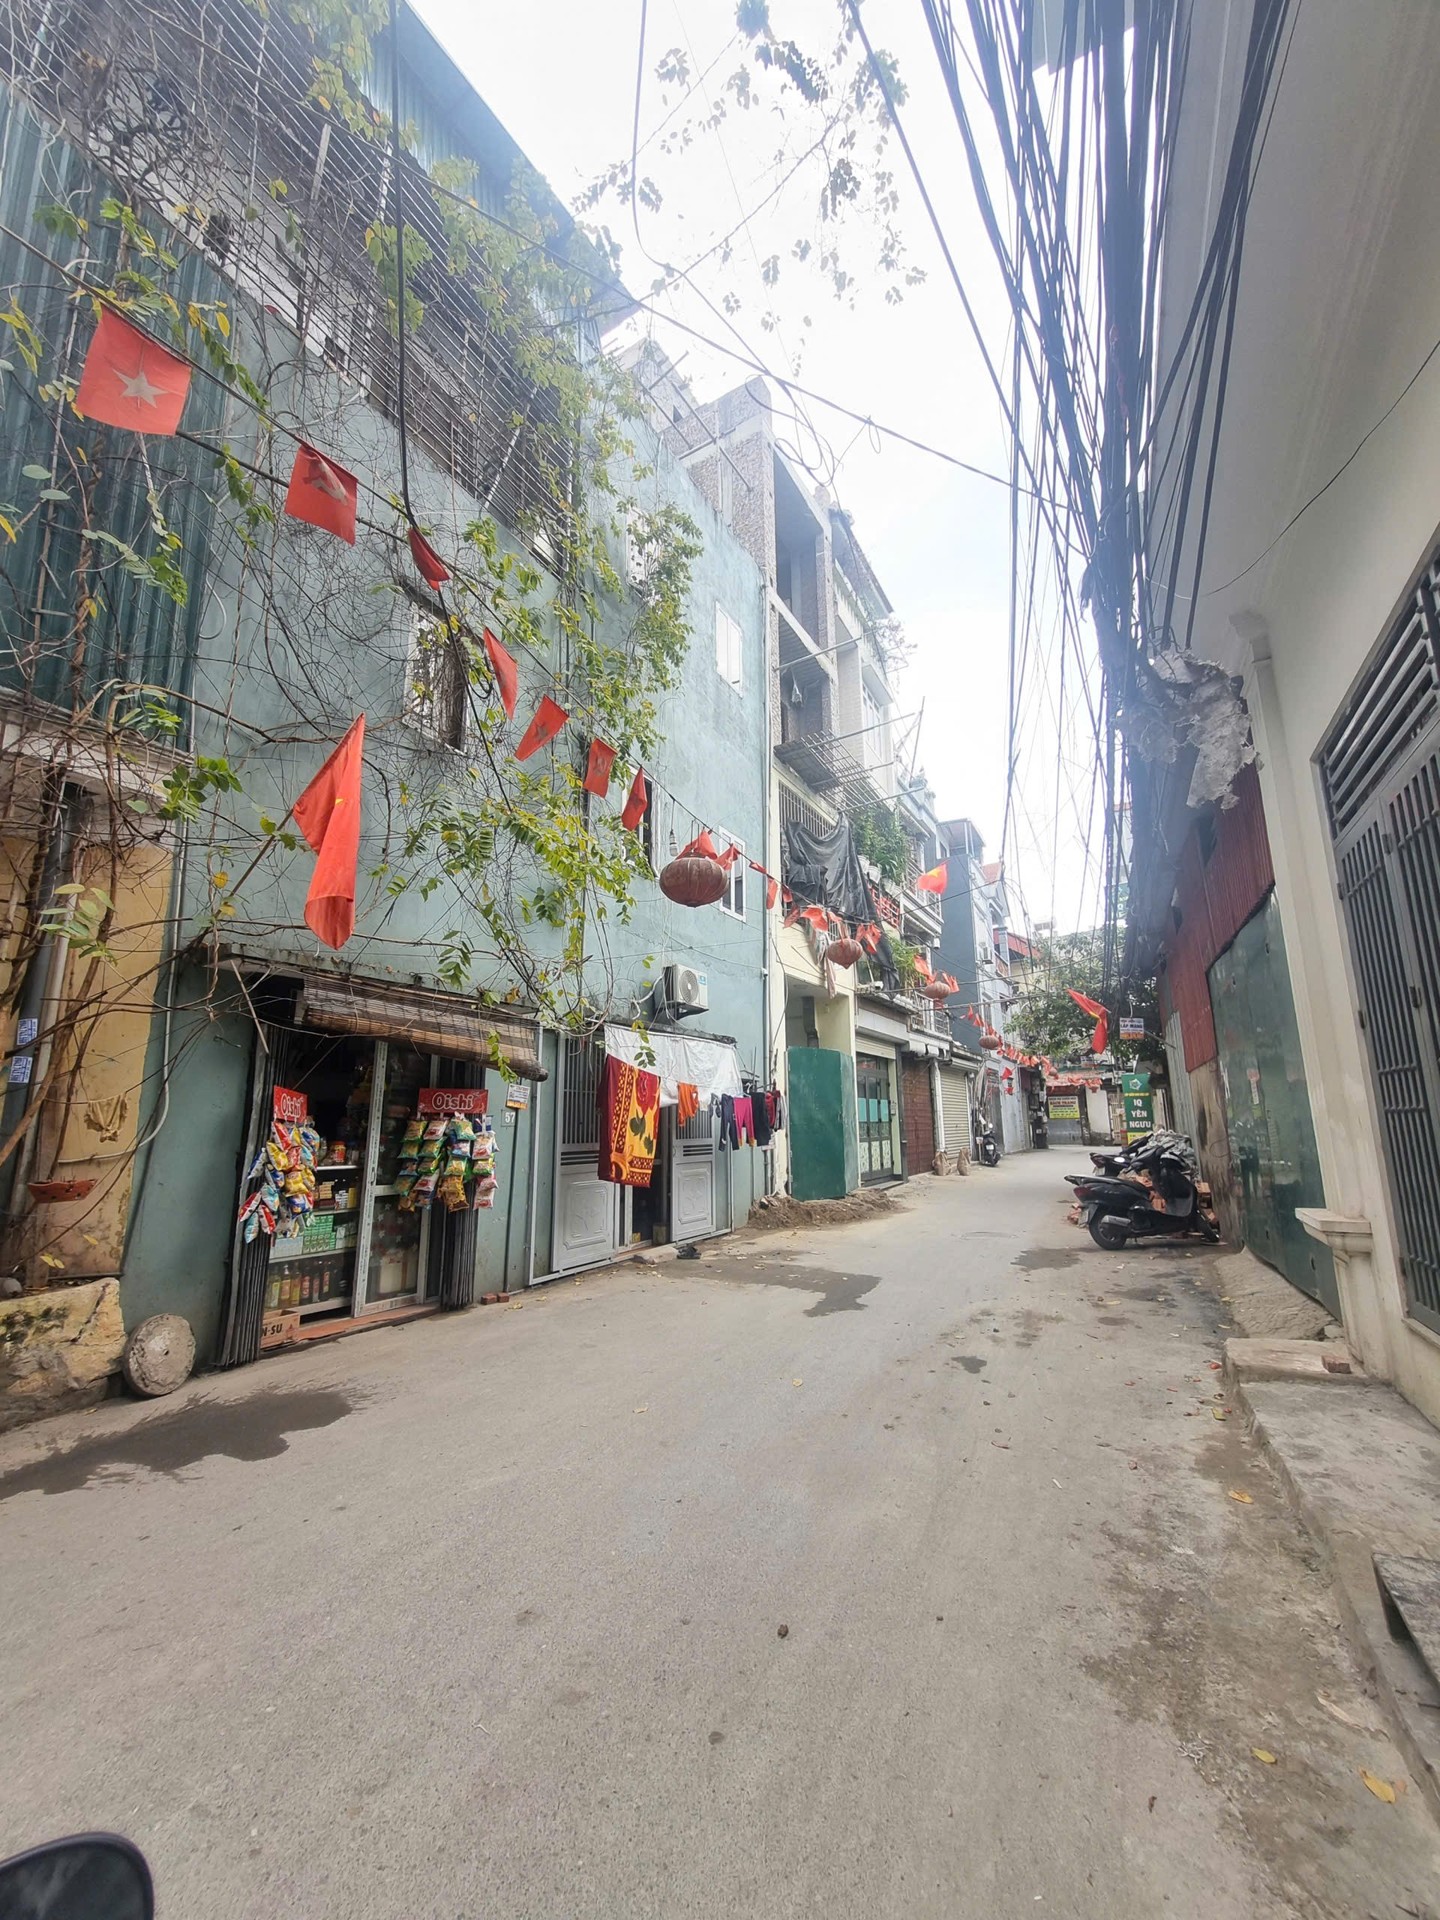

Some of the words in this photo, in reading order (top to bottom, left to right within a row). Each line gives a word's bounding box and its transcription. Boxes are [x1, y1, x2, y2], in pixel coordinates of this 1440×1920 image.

[281, 1093, 301, 1118] Oishi
[432, 1092, 474, 1110] Oishi
[505, 1111, 516, 1123] 57
